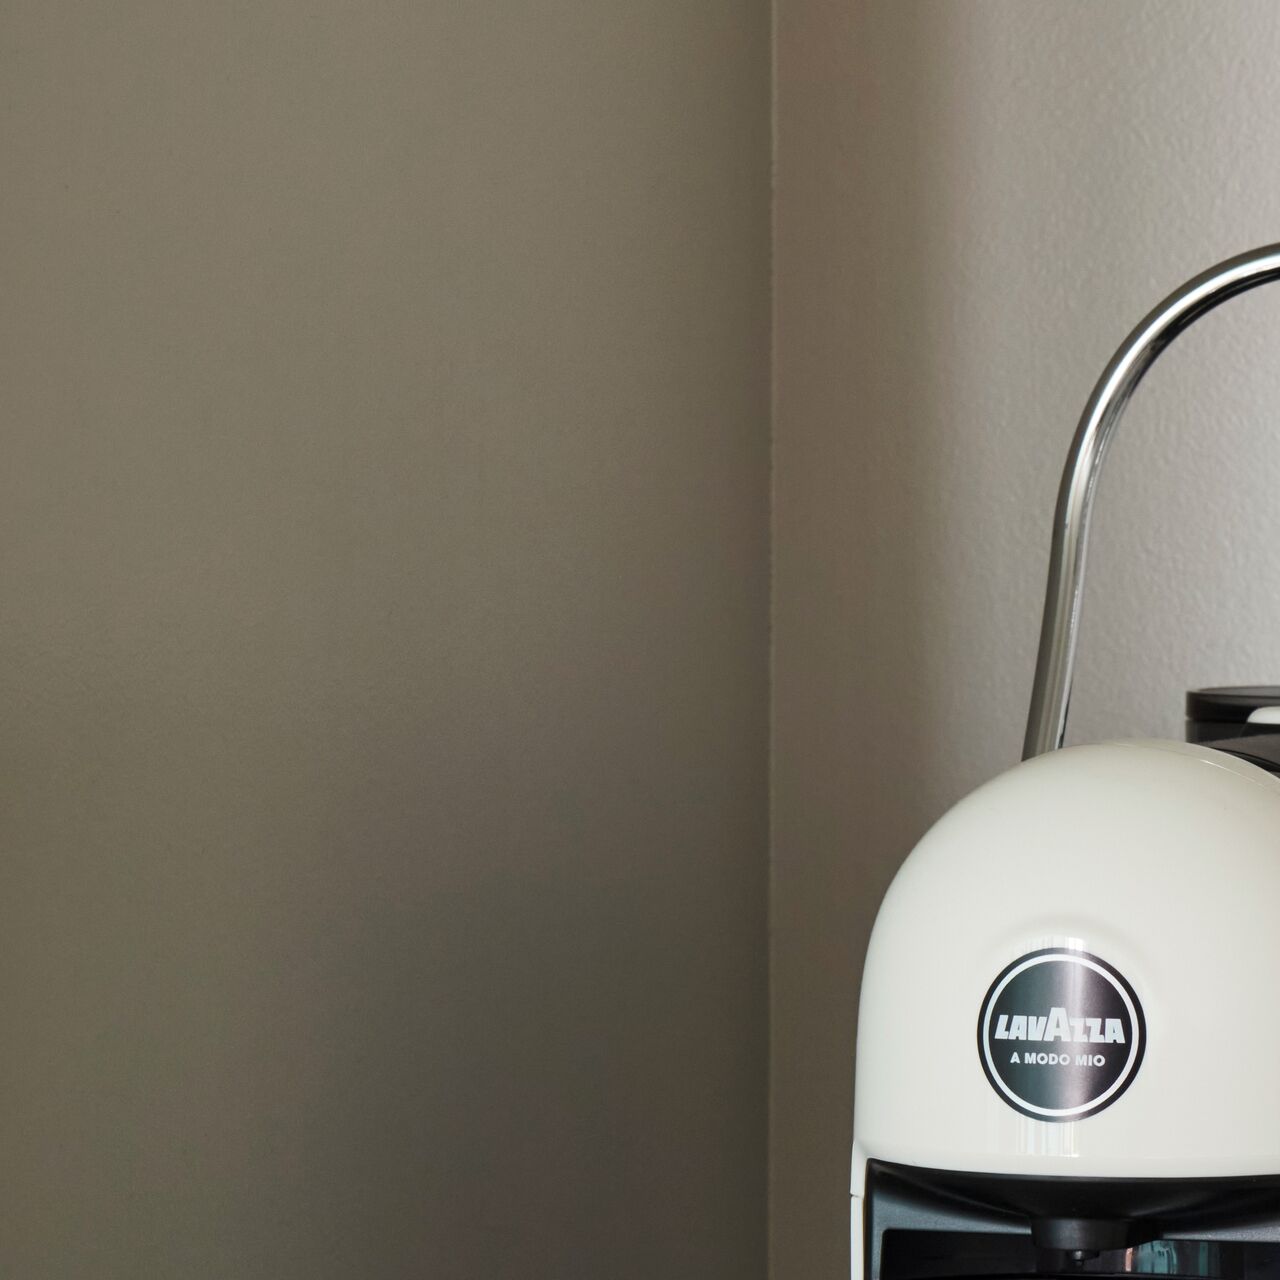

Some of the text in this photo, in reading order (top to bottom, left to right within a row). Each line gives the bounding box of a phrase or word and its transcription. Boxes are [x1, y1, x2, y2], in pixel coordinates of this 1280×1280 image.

[995, 1007, 1126, 1044] LAVAZZA
[1010, 1052, 1106, 1067] A MODO MIO
